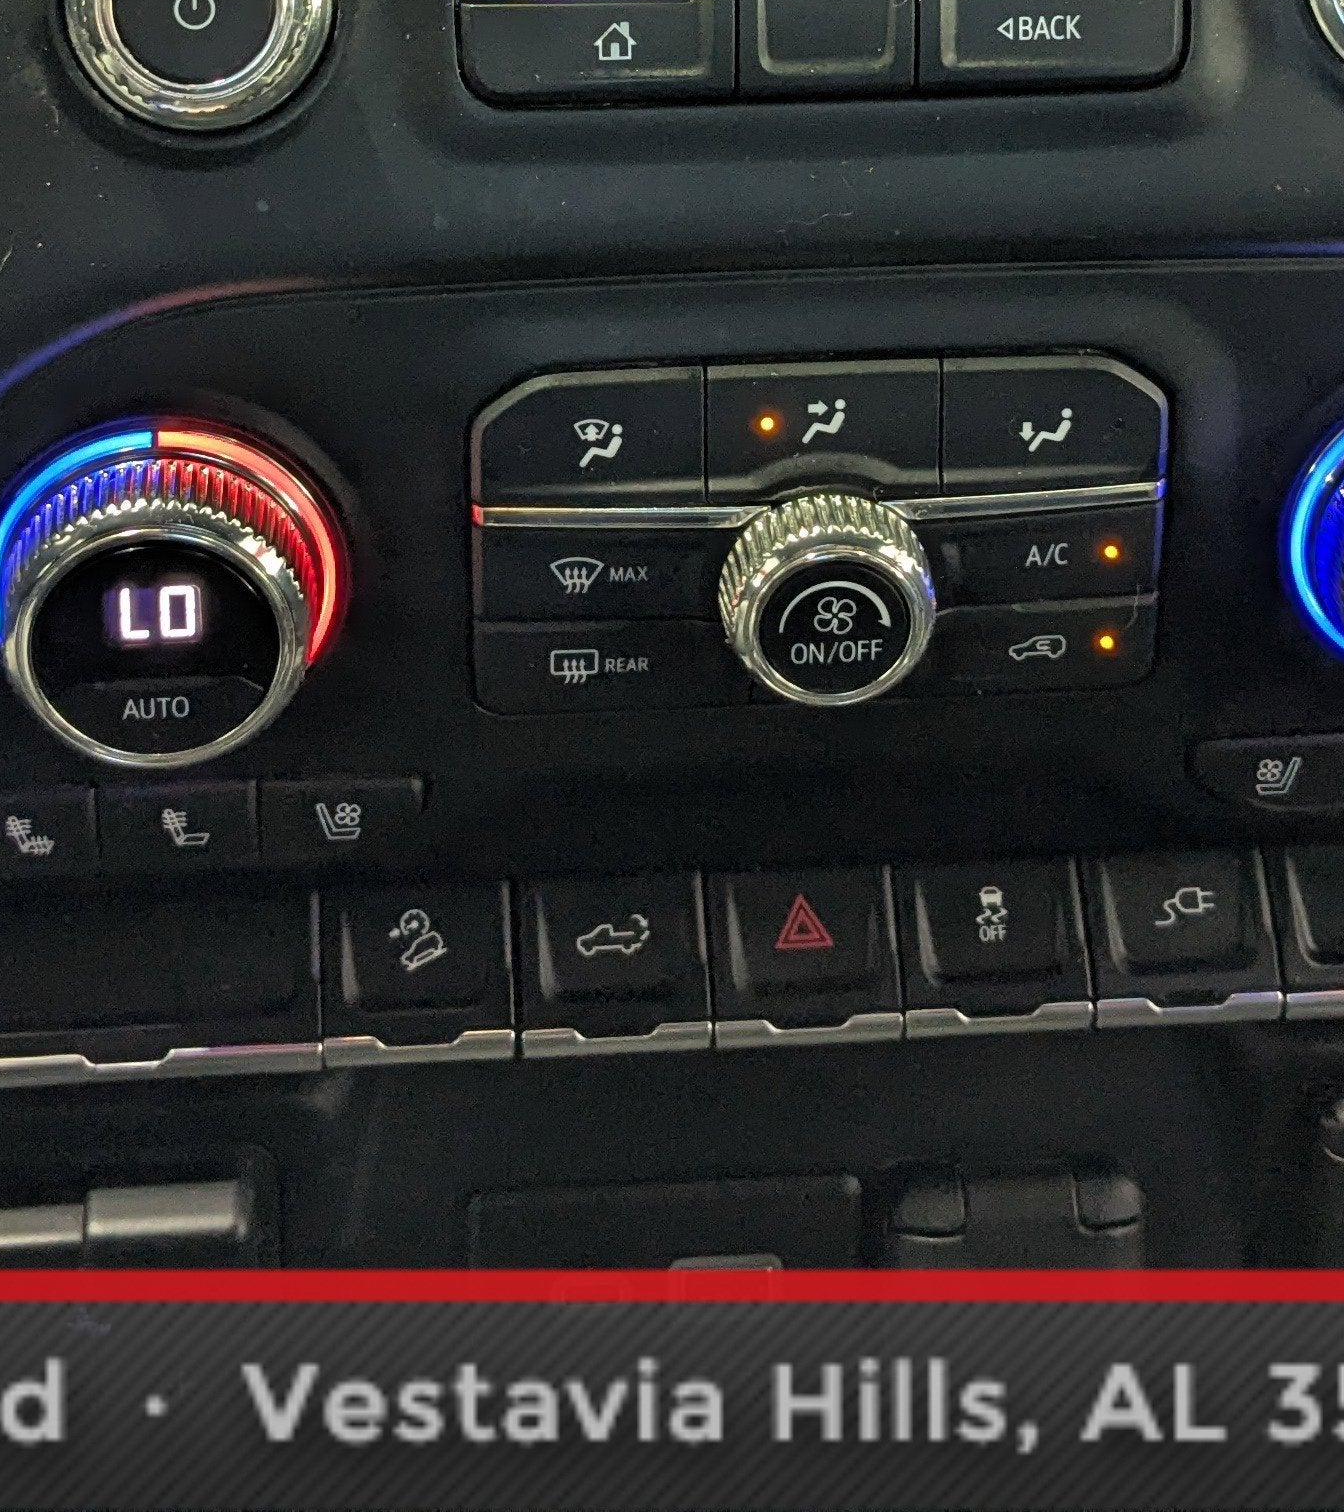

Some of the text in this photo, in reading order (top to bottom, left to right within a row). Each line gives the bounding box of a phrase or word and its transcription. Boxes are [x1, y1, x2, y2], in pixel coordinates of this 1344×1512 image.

[1018, 14, 1082, 41] BACK
[1025, 542, 1069, 568] A/C
[609, 566, 649, 583] MAX
[118, 584, 199, 640] LO
[790, 638, 884, 665] ON/OFF
[604, 656, 649, 673] REAR
[122, 695, 190, 720] AUTO
[978, 925, 1007, 942] OFF
